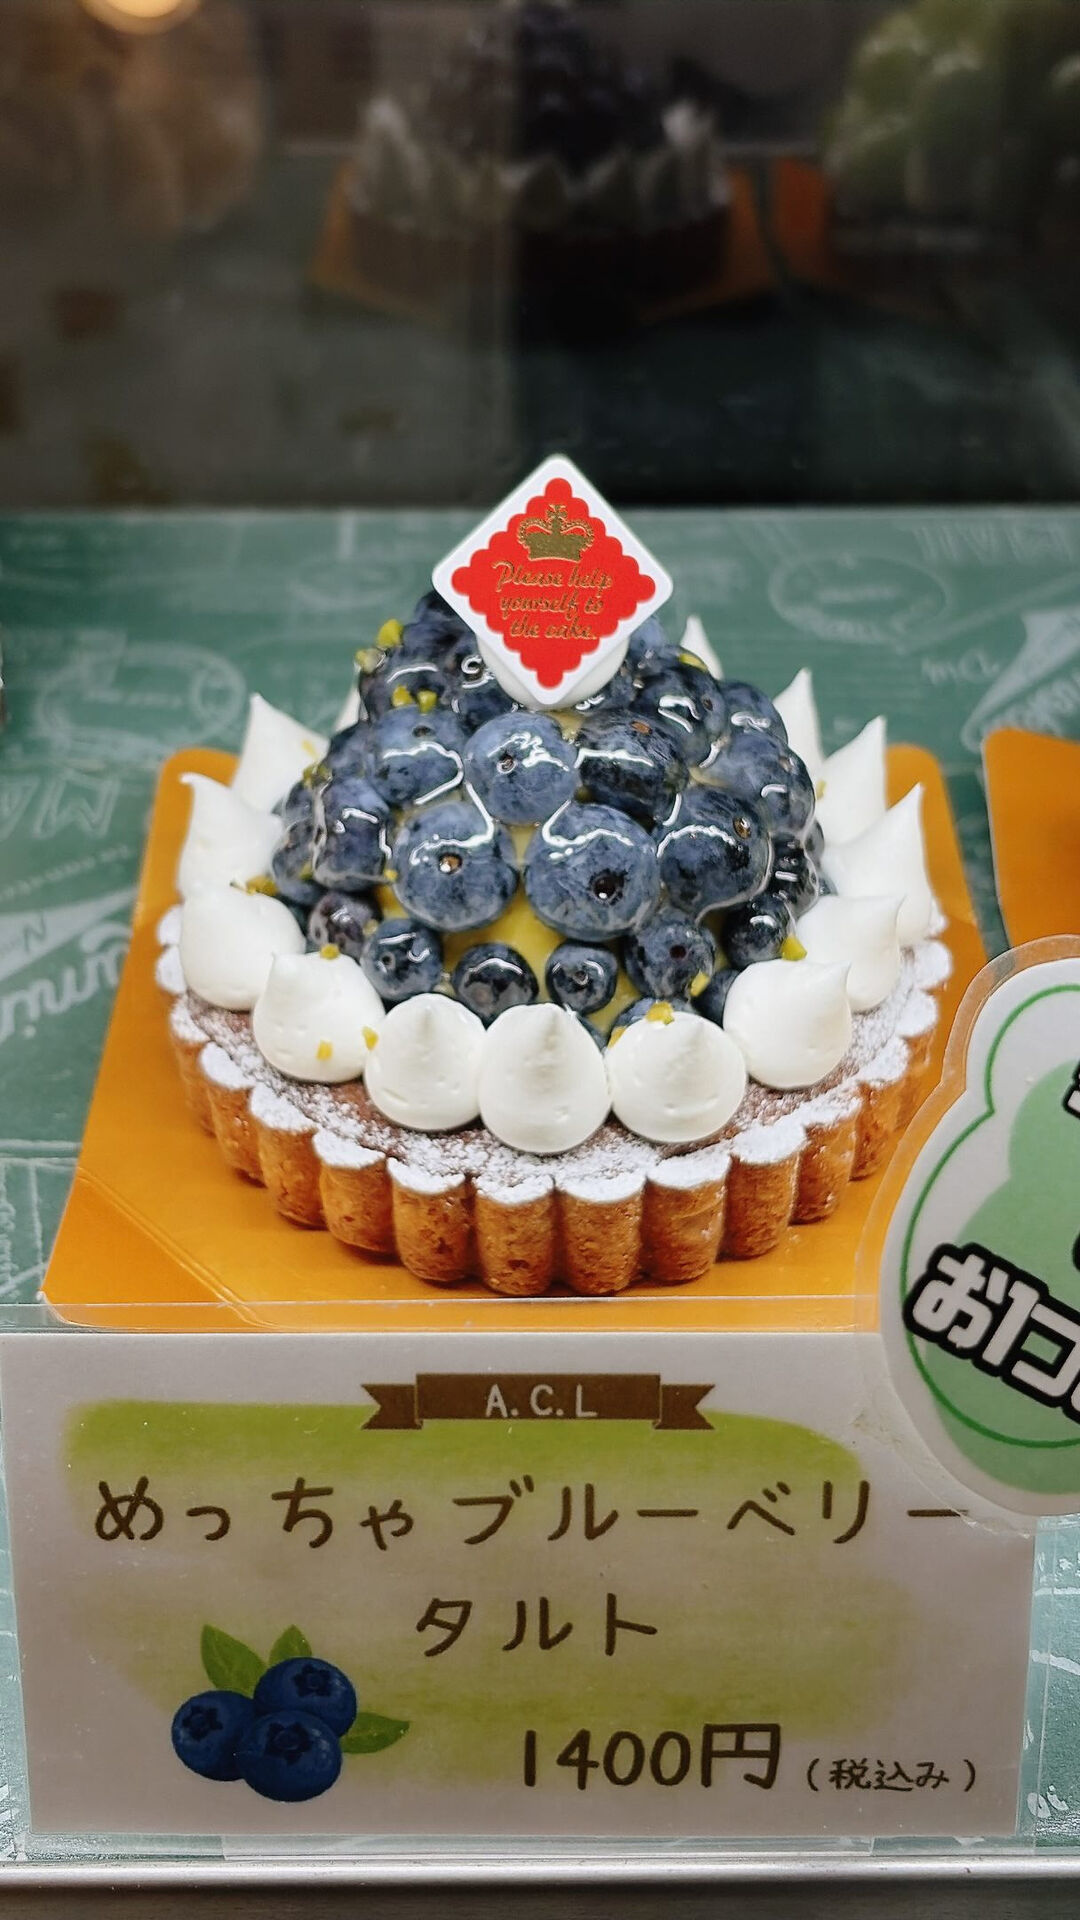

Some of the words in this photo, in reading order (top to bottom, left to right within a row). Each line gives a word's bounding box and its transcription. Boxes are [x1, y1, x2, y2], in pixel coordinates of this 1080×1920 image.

[491, 561, 563, 592] Please
[567, 566, 613, 598] help
[500, 587, 579, 621] yourself
[584, 597, 604, 615] to
[510, 614, 540, 638] the
[545, 616, 598, 640] cake.
[485, 1383, 598, 1418] A.C.L
[95, 1474, 968, 1552] めっちゃブルーベリー
[415, 1592, 658, 1657] タルト
[523, 1722, 781, 1790] 1400円
[805, 1757, 977, 1792] （税込み）
